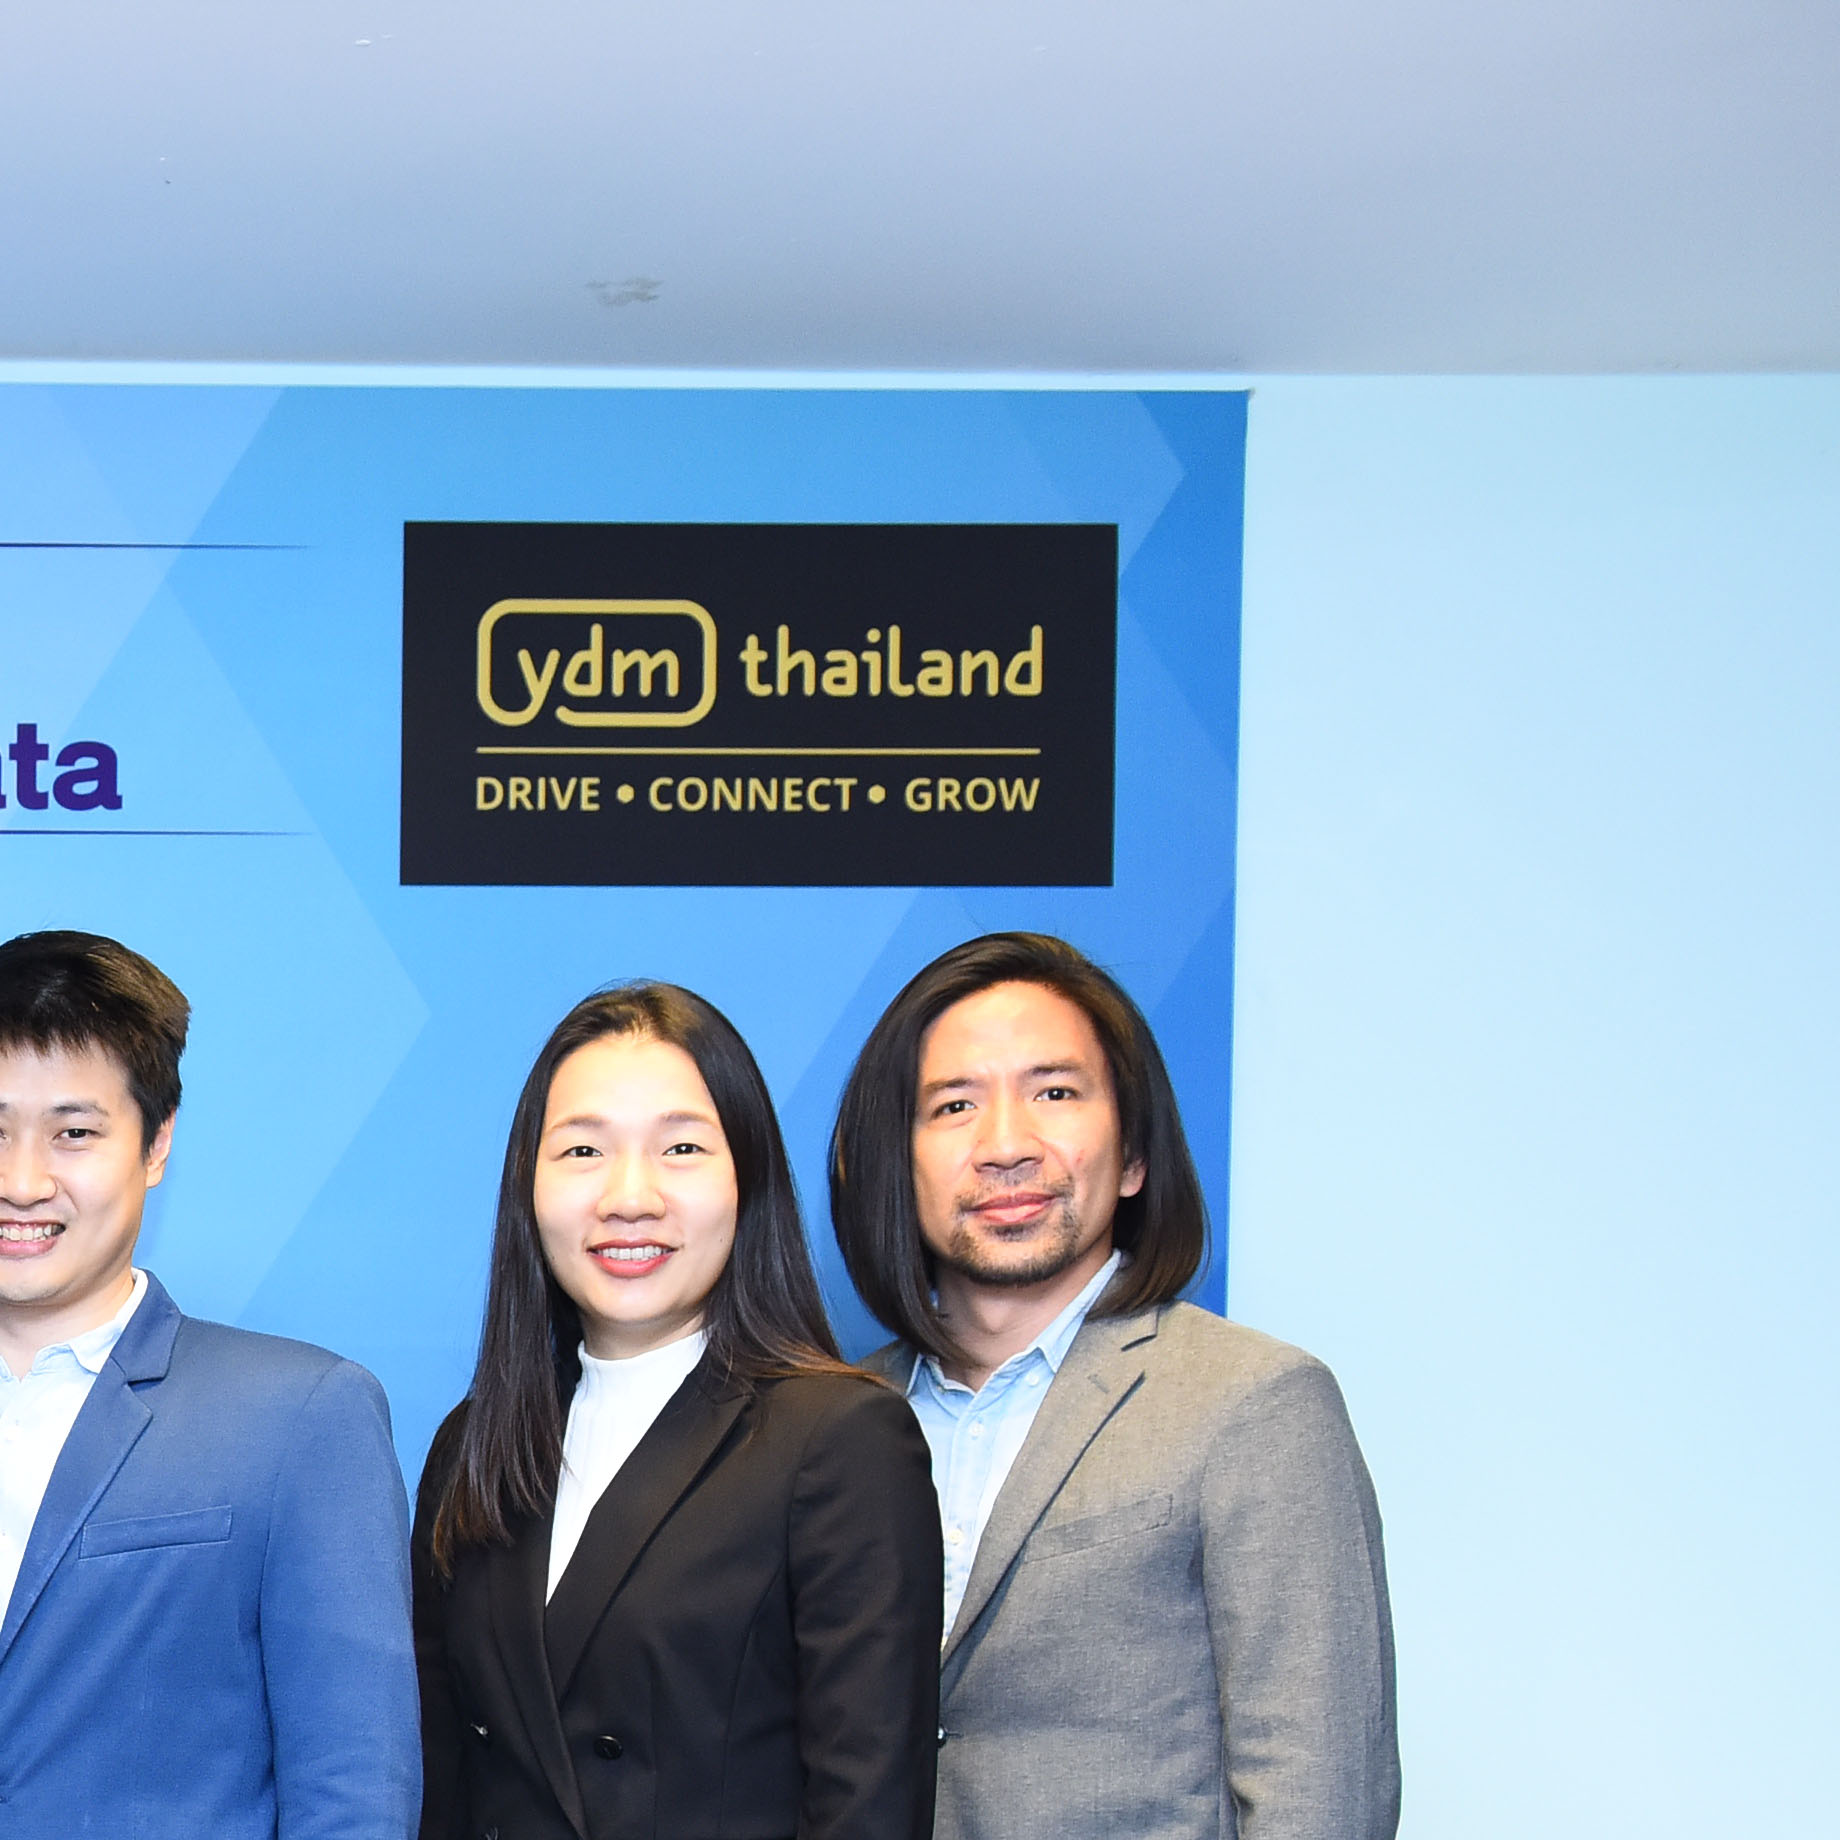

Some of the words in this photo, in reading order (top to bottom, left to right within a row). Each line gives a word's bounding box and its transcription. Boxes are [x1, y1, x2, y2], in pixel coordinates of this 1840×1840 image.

[508, 622, 682, 727] ydm
[740, 624, 1043, 697] thailand
[476, 776, 601, 811] DRIVE
[649, 777, 858, 812] CONNECT
[905, 777, 1040, 812] GROW
